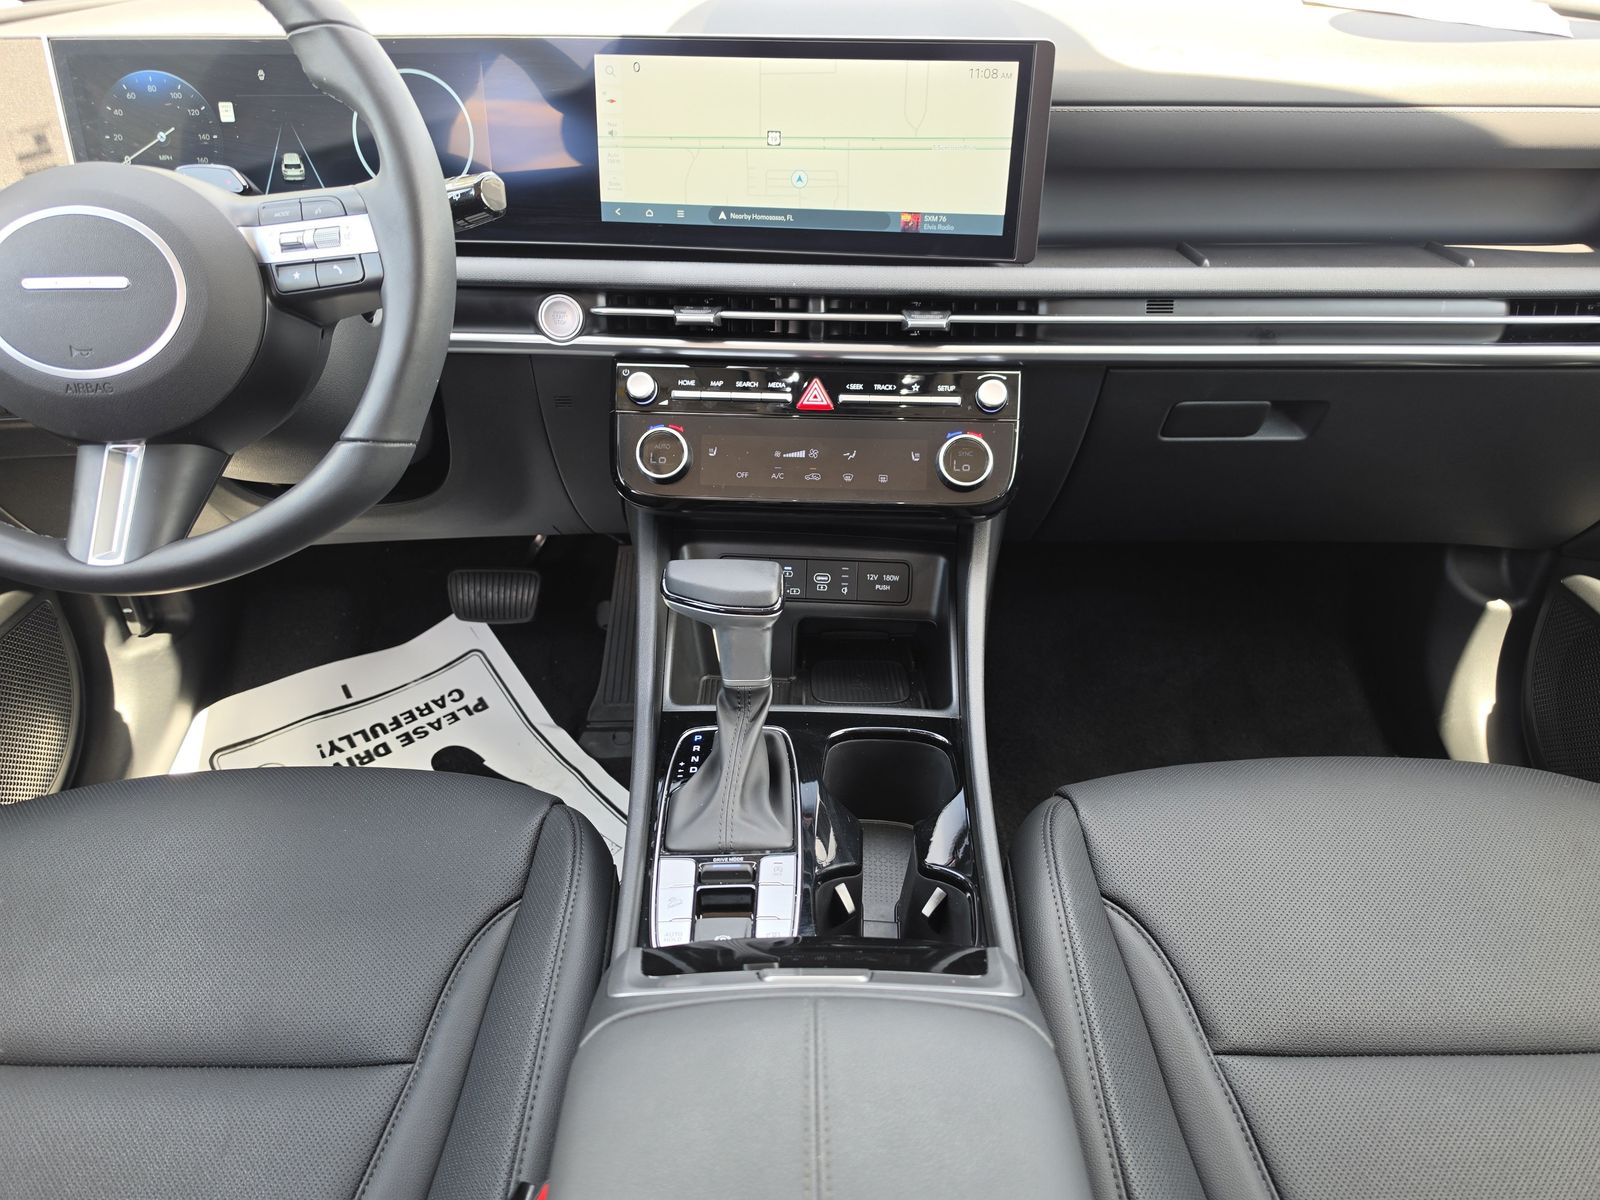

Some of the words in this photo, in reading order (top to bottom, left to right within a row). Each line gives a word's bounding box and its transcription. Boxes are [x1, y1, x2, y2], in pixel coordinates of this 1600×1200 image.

[969, 68, 999, 80] 11:08
[1000, 72, 1013, 80] AM
[147, 84, 157, 93] 80
[126, 92, 136, 100] 60
[170, 92, 182, 100] 100
[113, 108, 124, 117] 40
[187, 108, 200, 117] 120
[198, 133, 210, 141] 140
[730, 212, 752, 221] Nearby
[786, 214, 794, 222] FL
[938, 215, 947, 223] 76
[923, 223, 937, 231] Elvis
[937, 223, 955, 231] Radio
[65, 382, 114, 394] AIRBAG
[654, 442, 671, 450] AUTO
[736, 471, 749, 479] OFF
[771, 472, 785, 480] A/C
[866, 573, 878, 581] 12V
[882, 574, 900, 582] 180W
[316, 688, 465, 759] CAREFULLY!
[395, 696, 490, 748] PLEASE
[332, 741, 393, 767] DRI
